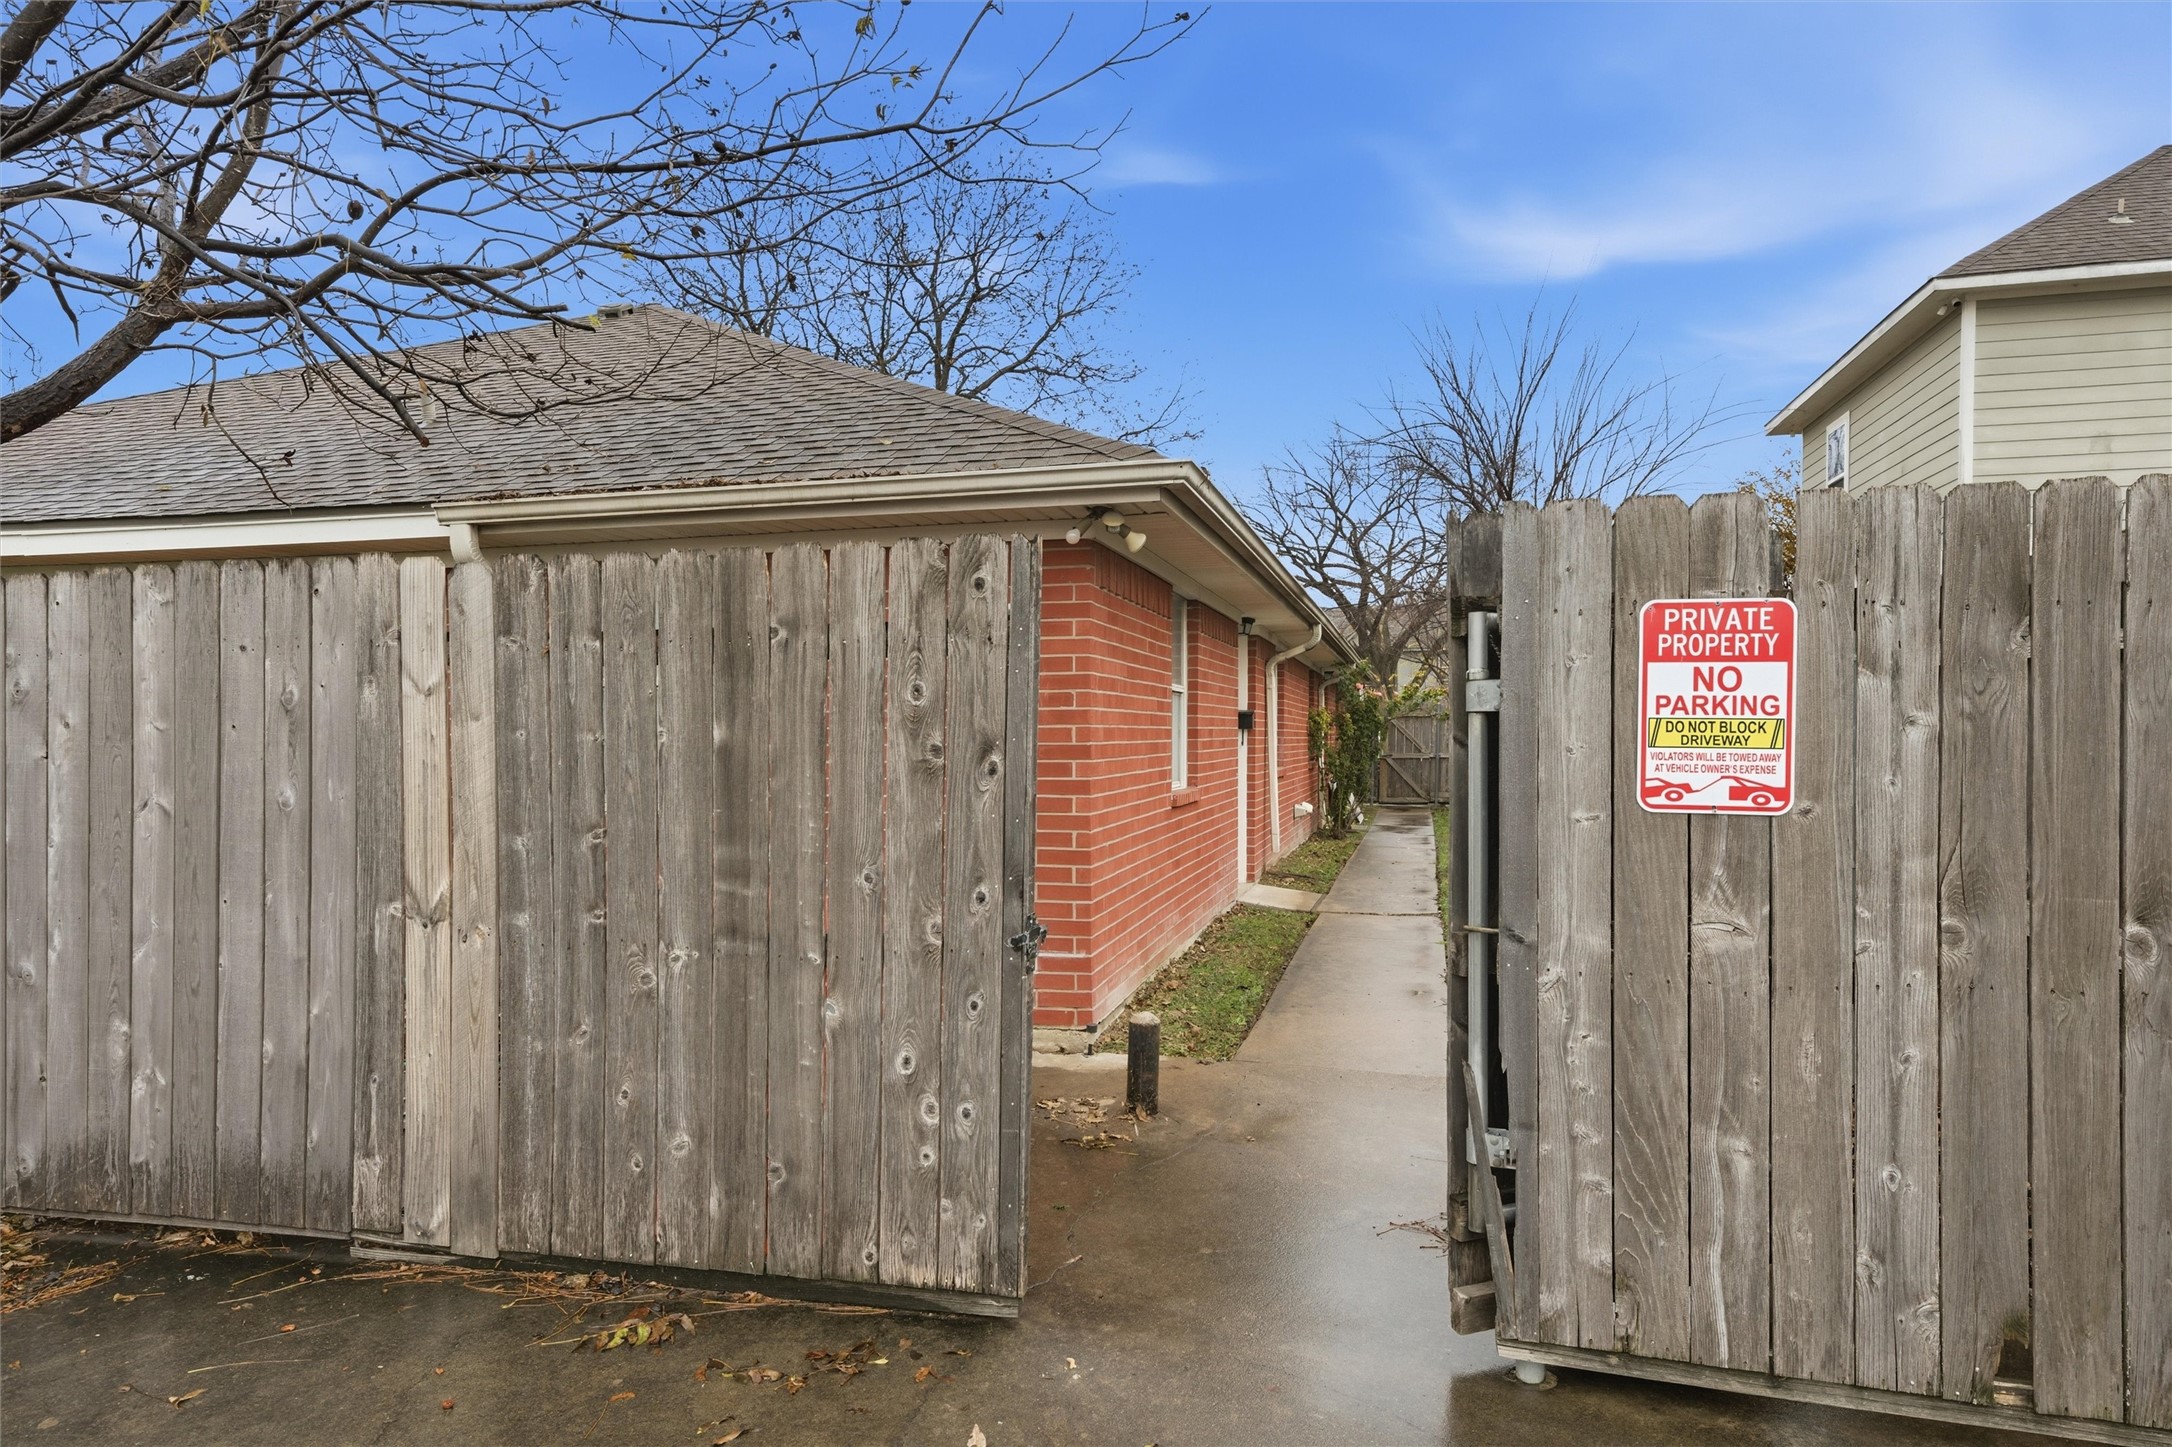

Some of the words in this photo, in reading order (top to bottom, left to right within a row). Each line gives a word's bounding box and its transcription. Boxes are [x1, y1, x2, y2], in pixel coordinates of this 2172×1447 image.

[1664, 607, 1774, 631] PRIVATE
[1658, 633, 1779, 656] PROPERTY
[1693, 666, 1742, 692] NO
[1655, 695, 1780, 716] PARKING
[1665, 721, 1684, 733] DO
[1688, 721, 1714, 733] NOT
[1719, 721, 1767, 734] BLOCK
[1680, 735, 1751, 746] DRIVEWAY
[1650, 752, 1694, 761] VIOLATORS
[1696, 752, 1714, 762] WILL
[1716, 753, 1727, 762] BE
[1728, 753, 1758, 762] TOWED
[1759, 753, 1782, 763] AWAY
[1655, 764, 1664, 773] AT
[1665, 764, 1699, 773] VEHICLE
[1700, 764, 1738, 774] OWNER'S
[1740, 765, 1776, 774] EXPENSE
